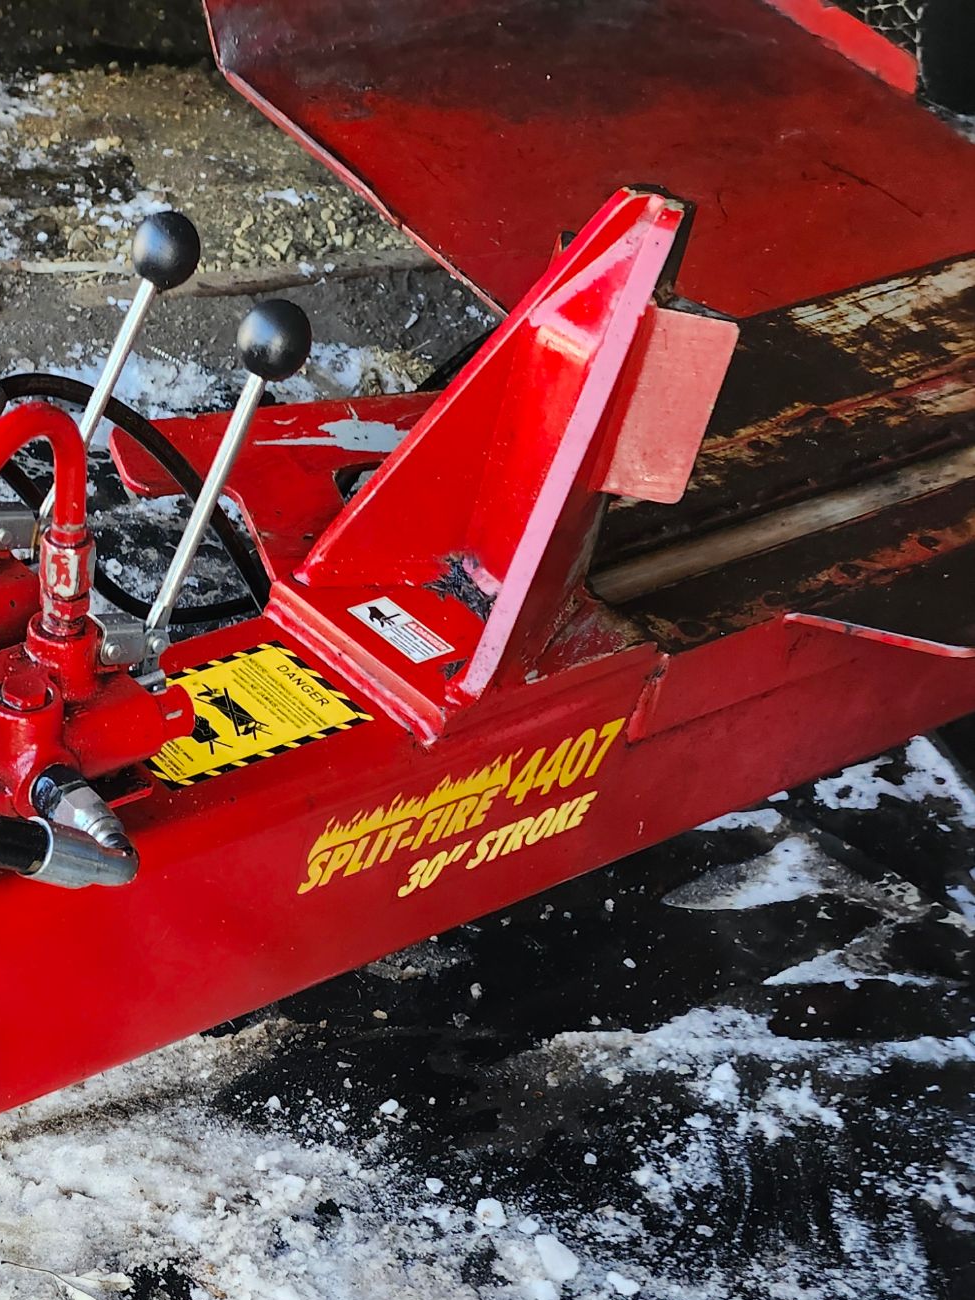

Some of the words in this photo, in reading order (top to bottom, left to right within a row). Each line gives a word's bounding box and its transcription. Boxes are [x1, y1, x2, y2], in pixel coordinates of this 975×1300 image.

[276, 664, 330, 707] DANGER
[298, 785, 502, 895] SPLIT-FIRE
[505, 717, 626, 806] 4407
[397, 840, 473, 898] 30"
[465, 790, 599, 870] STROKE
